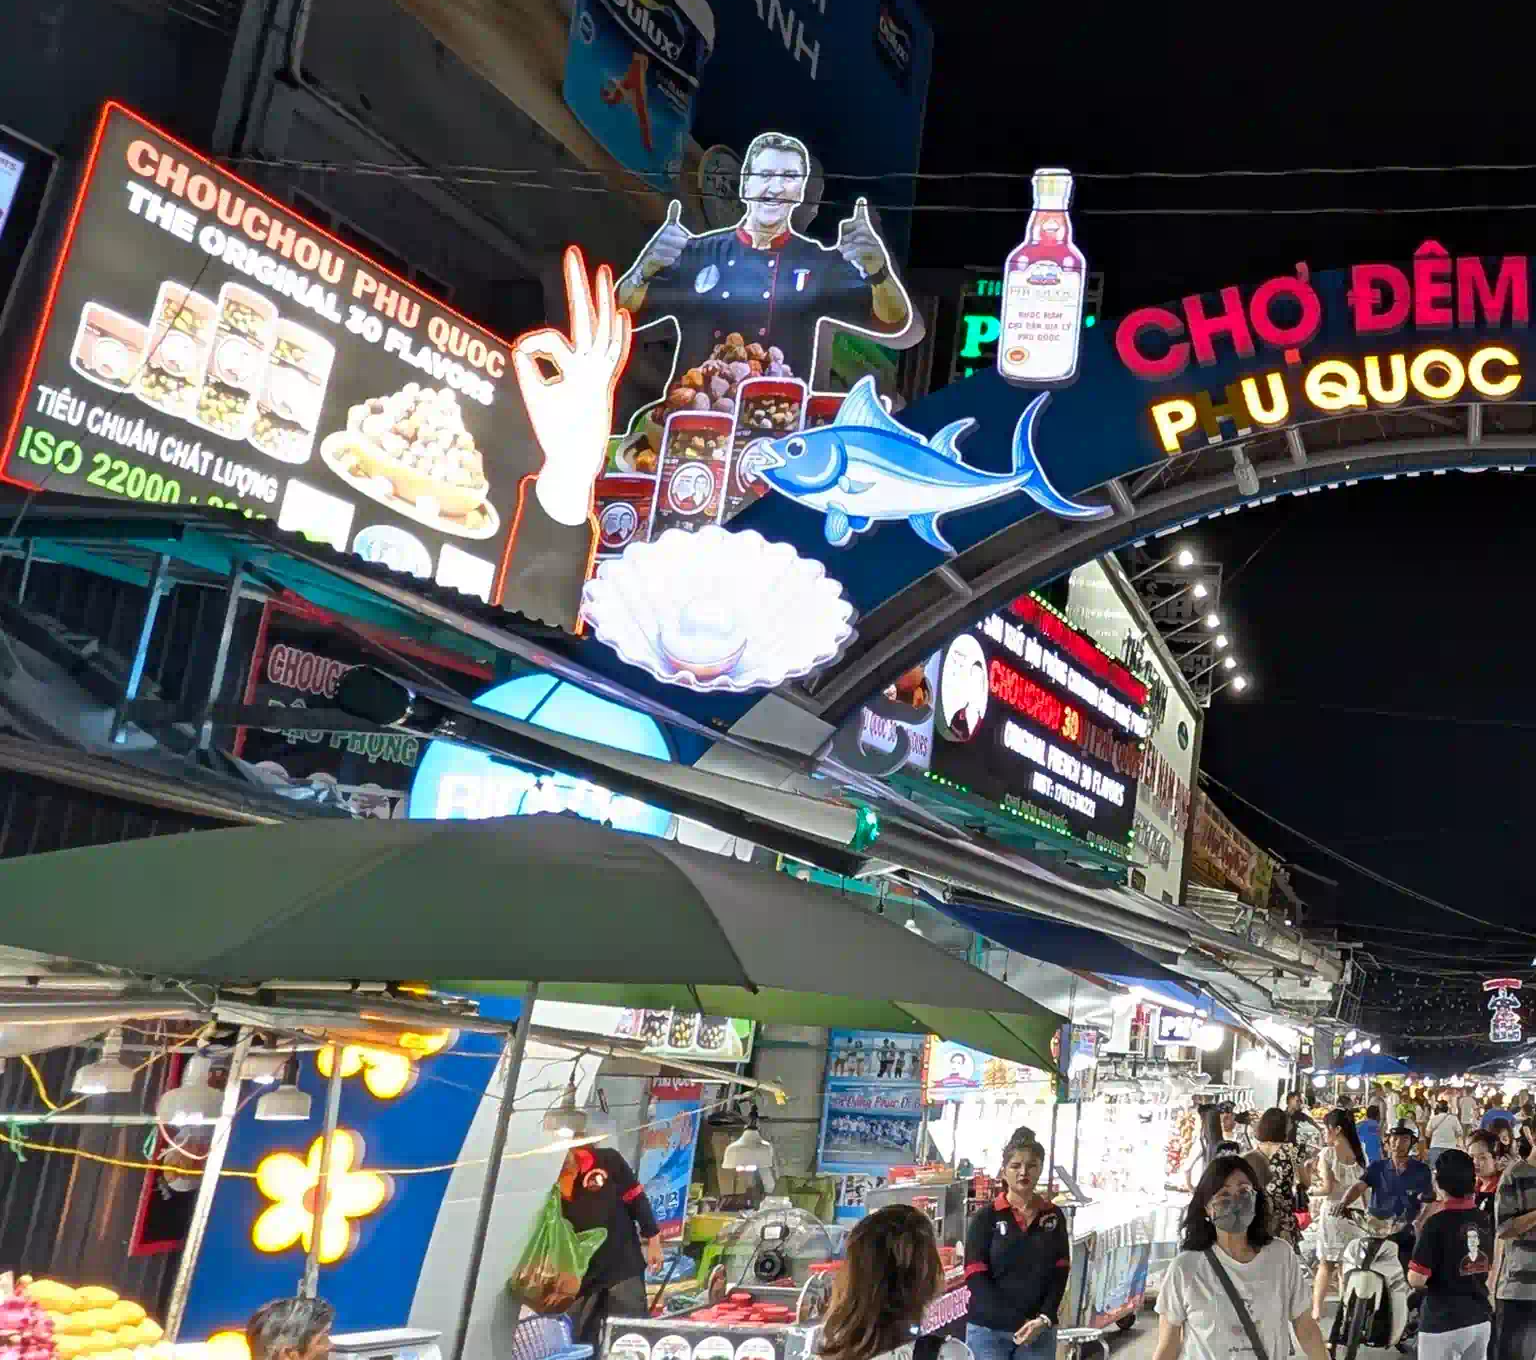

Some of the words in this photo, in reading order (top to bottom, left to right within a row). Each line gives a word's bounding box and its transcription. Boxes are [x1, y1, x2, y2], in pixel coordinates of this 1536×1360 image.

[126, 139, 345, 285] CHOUCHOU
[350, 267, 421, 329] PHU
[427, 315, 505, 378] QUOC
[126, 181, 200, 244] THE
[199, 226, 342, 324] ORIGINAL
[344, 303, 384, 343] 30
[383, 331, 497, 406] FLAVORS
[1115, 261, 1321, 376] CHỢ
[1347, 238, 1530, 336] ĐÊM
[36, 384, 87, 427] TIÊU
[1303, 346, 1523, 411] QUOC
[17, 425, 84, 474] ISO
